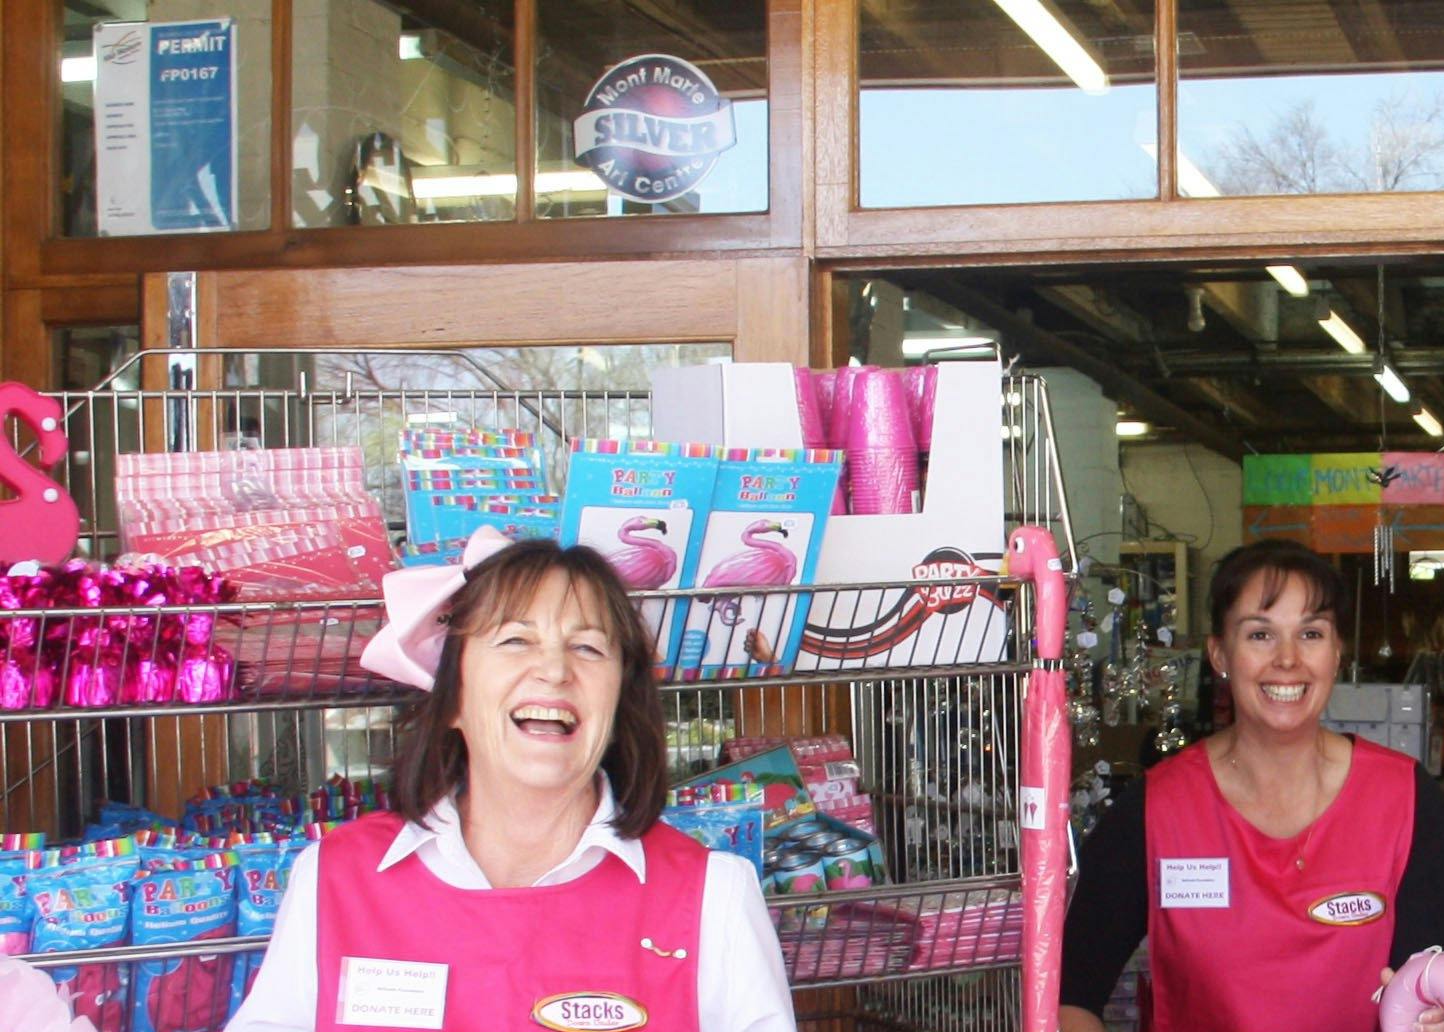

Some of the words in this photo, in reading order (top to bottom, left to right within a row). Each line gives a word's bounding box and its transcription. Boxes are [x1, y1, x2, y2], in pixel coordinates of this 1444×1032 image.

[157, 35, 227, 56] PERMIT
[597, 67, 647, 106] Mont
[594, 112, 718, 151] SILVER
[598, 158, 629, 186] Art
[913, 562, 981, 581] PARTY
[141, 868, 233, 903] PARTY
[1326, 898, 1373, 917] Stacks
[351, 1003, 401, 1015] DONATE
[403, 1006, 436, 1017] HERE
[560, 1000, 625, 1020] Stacks
